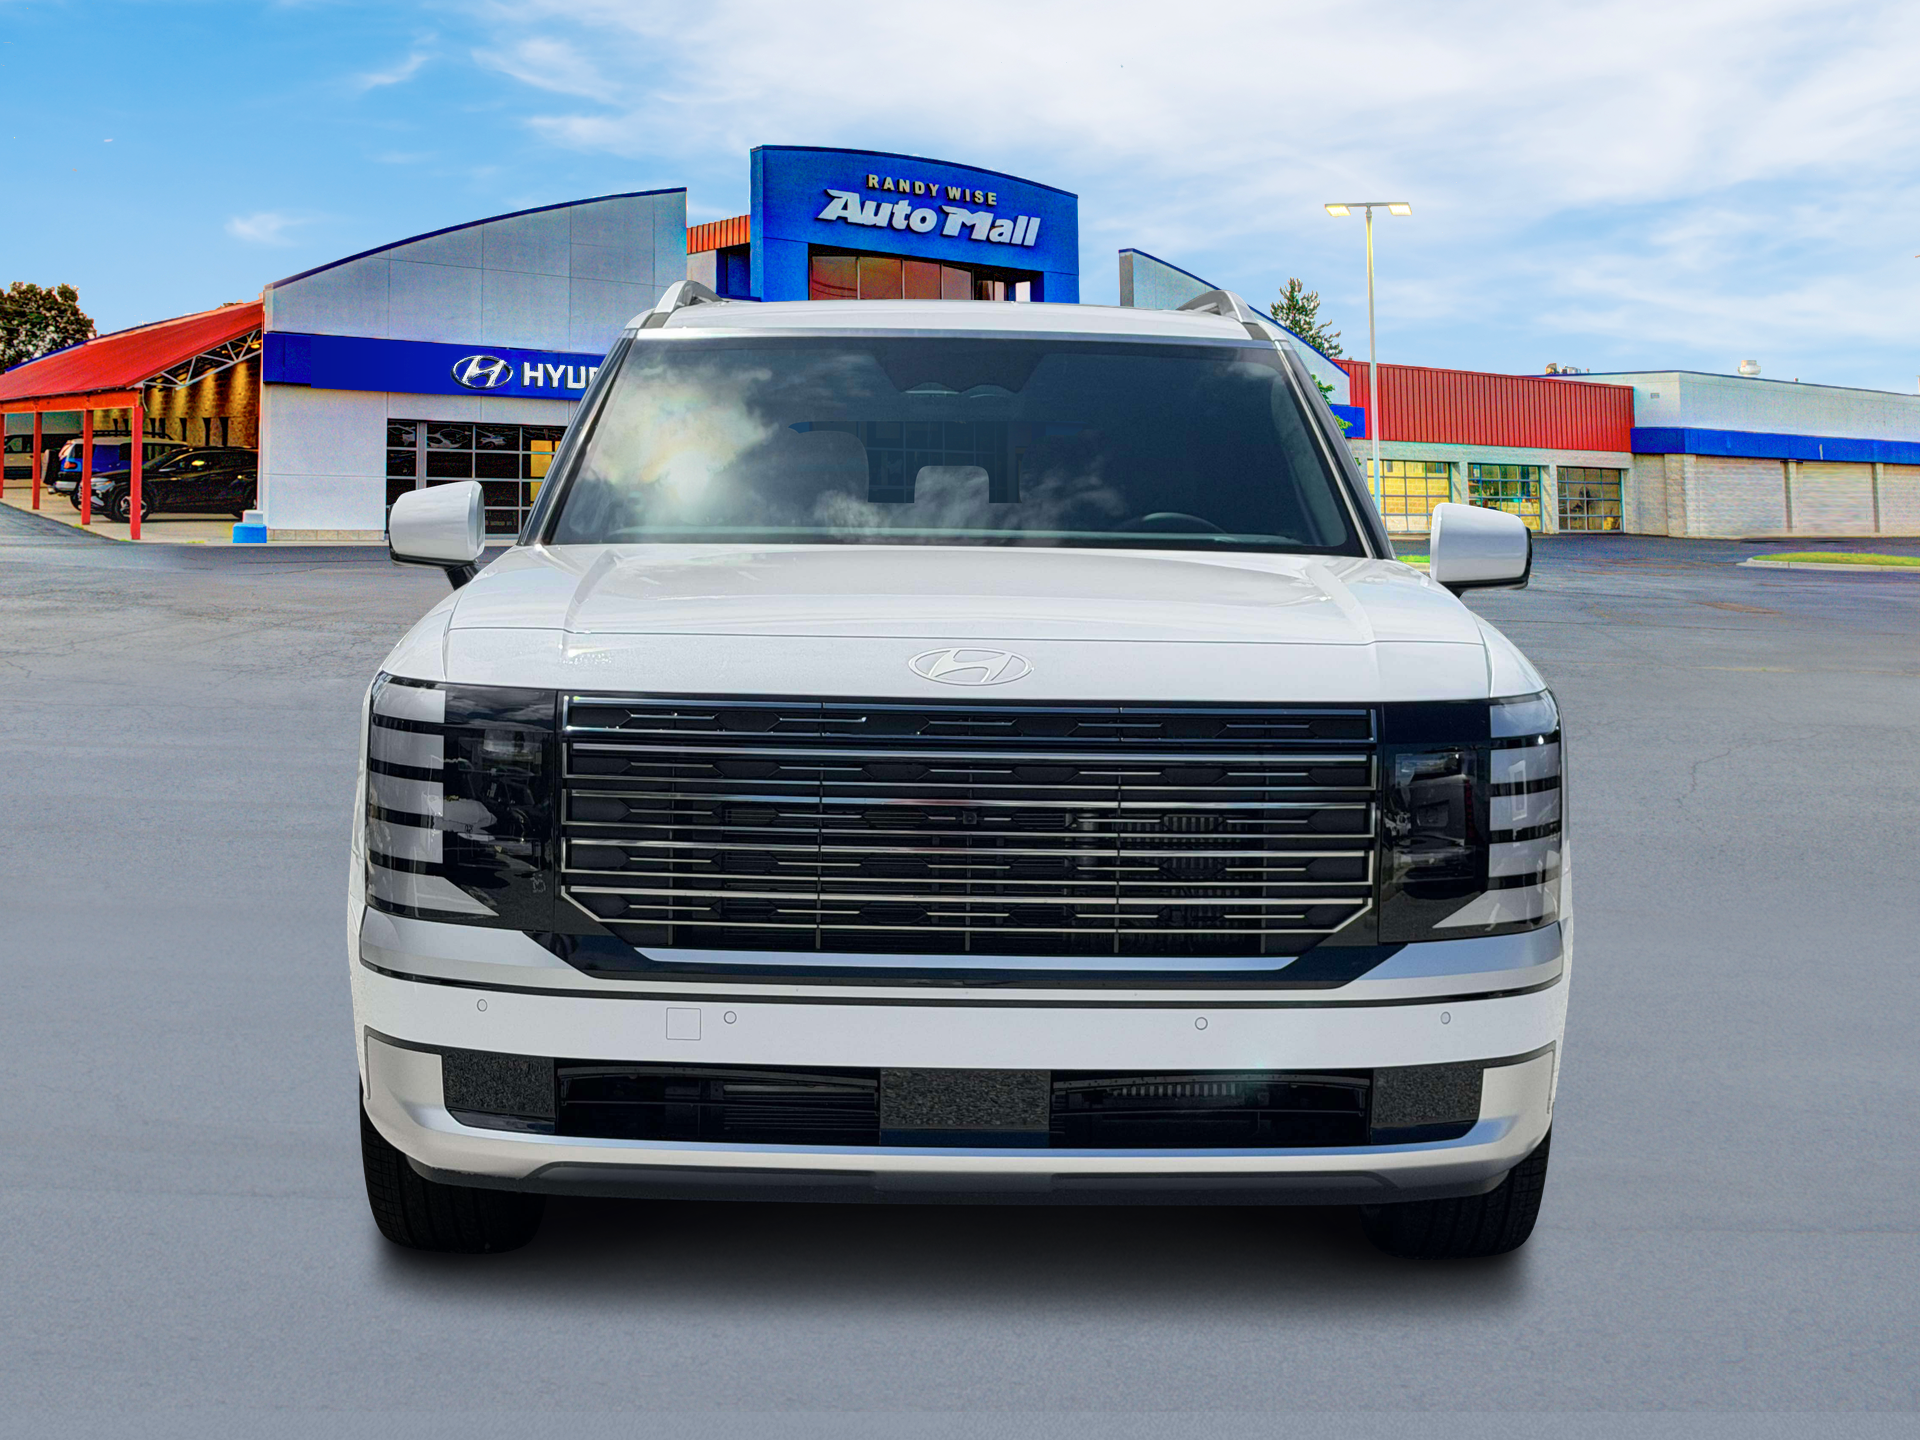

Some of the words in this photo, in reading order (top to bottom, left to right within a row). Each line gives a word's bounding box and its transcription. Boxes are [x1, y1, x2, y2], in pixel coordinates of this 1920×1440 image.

[867, 173, 940, 197] RANDY
[946, 185, 998, 206] WISE
[816, 188, 938, 233] Auto
[941, 204, 1041, 247] Mall
